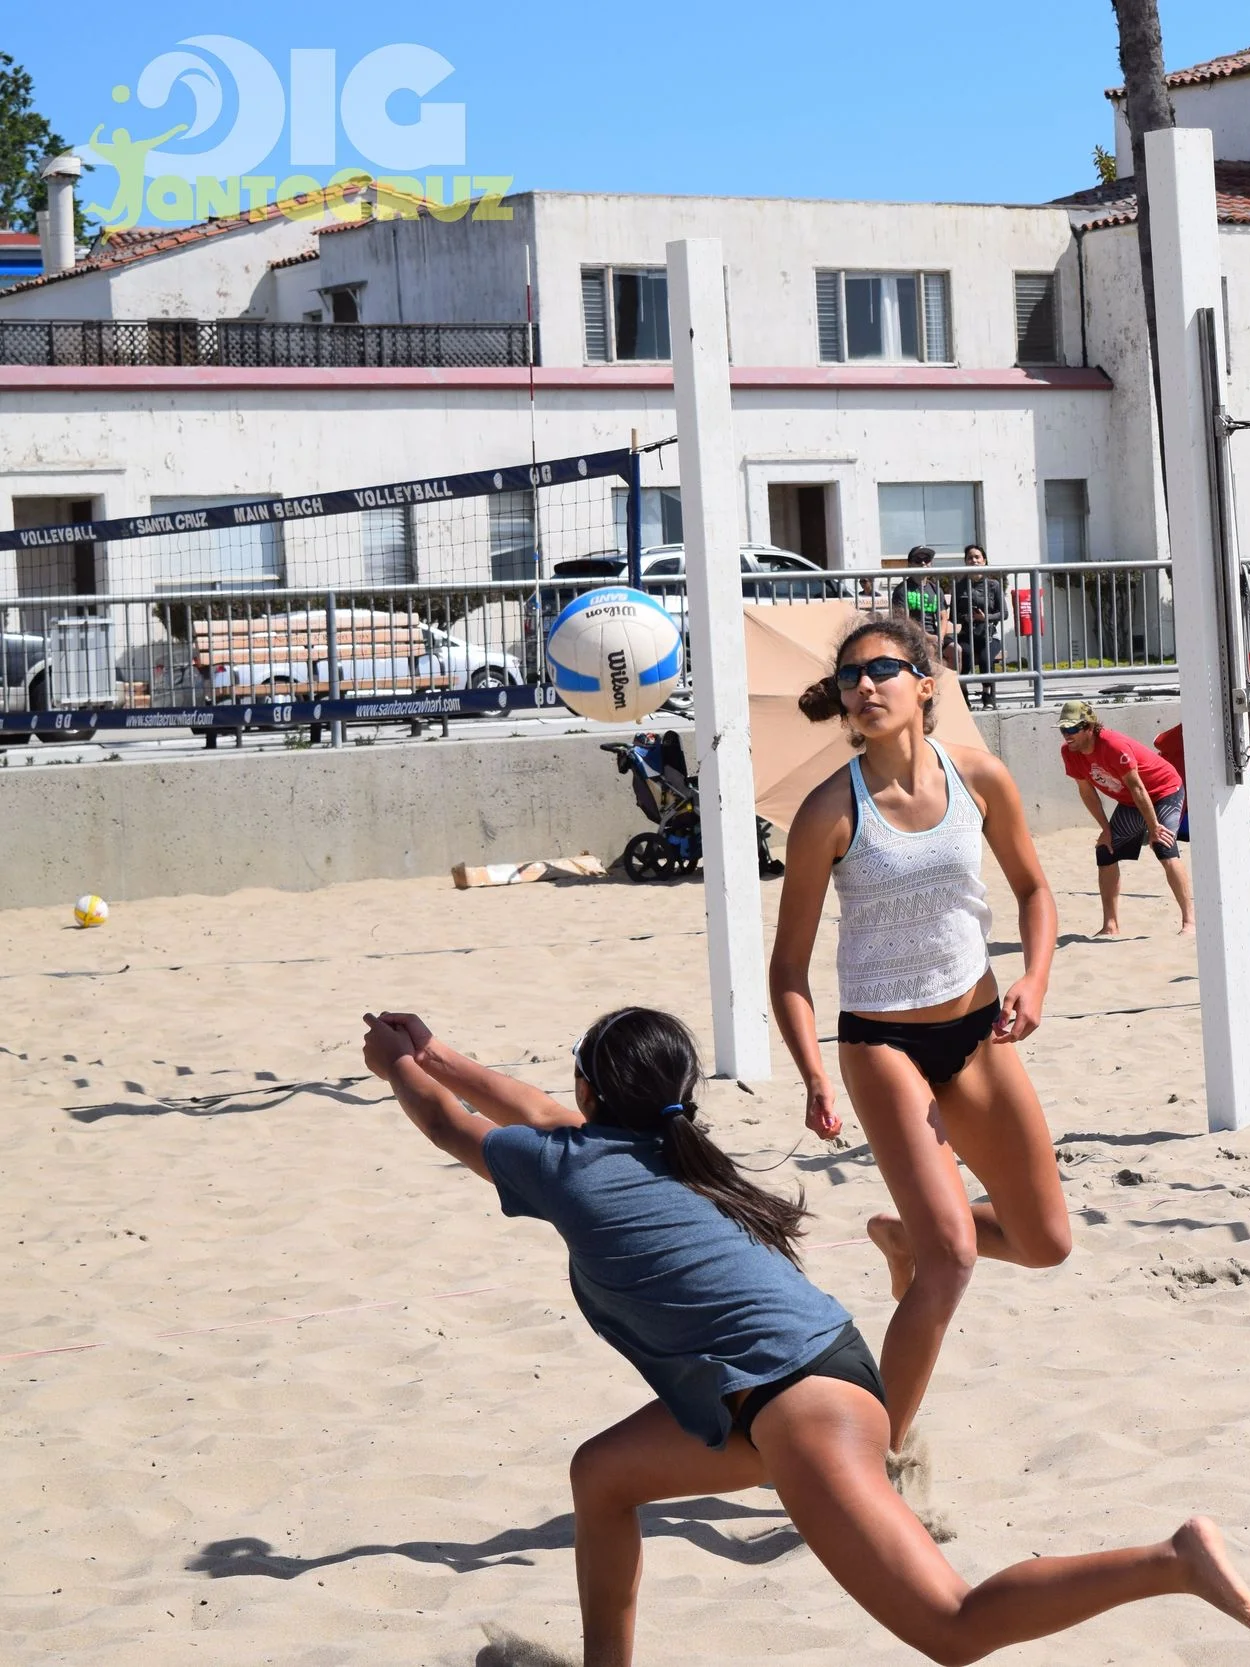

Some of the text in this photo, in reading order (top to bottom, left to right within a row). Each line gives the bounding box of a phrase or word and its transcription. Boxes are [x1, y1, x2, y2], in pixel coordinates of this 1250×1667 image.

[353, 480, 453, 508] VOLLEYBALL
[233, 497, 324, 523] MAIN BEACH
[136, 516, 174, 535] SANTA
[175, 511, 209, 530] CRUZ
[20, 525, 97, 546] VOLLEYBALL
[590, 592, 629, 606] SAND
[585, 605, 637, 619] Wilson
[607, 649, 630, 711] Wilson
[356, 697, 461, 717] www.santacruzwharf.com
[126, 710, 214, 727] www.santacruzwharf.com
